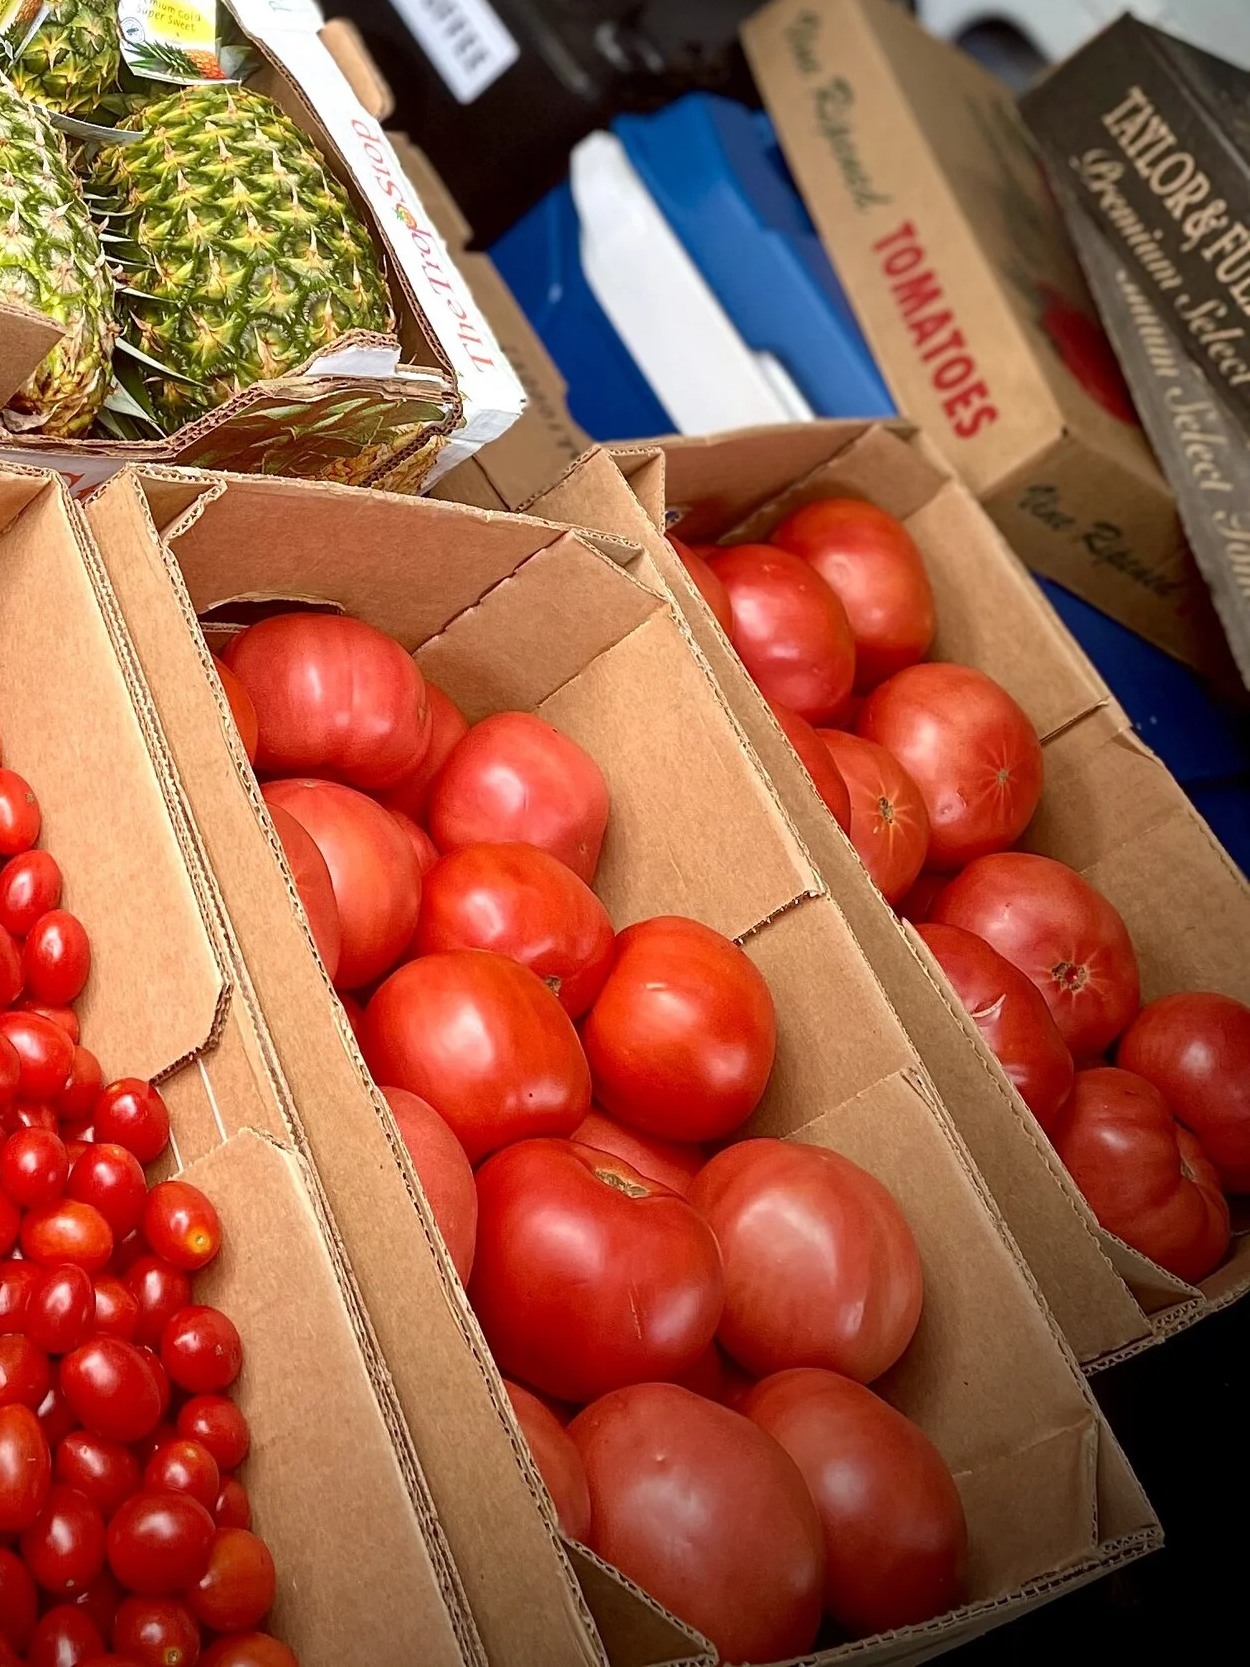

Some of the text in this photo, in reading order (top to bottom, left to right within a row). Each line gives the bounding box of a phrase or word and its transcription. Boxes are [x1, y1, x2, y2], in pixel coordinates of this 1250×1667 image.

[136, 4, 196, 32] Super Sweet
[1069, 148, 1183, 290] Premium
[1102, 86, 1211, 221] TAYLOR
[1179, 199, 1229, 252] &
[872, 219, 999, 440] TOMATOES
[1165, 371, 1234, 494] Select
